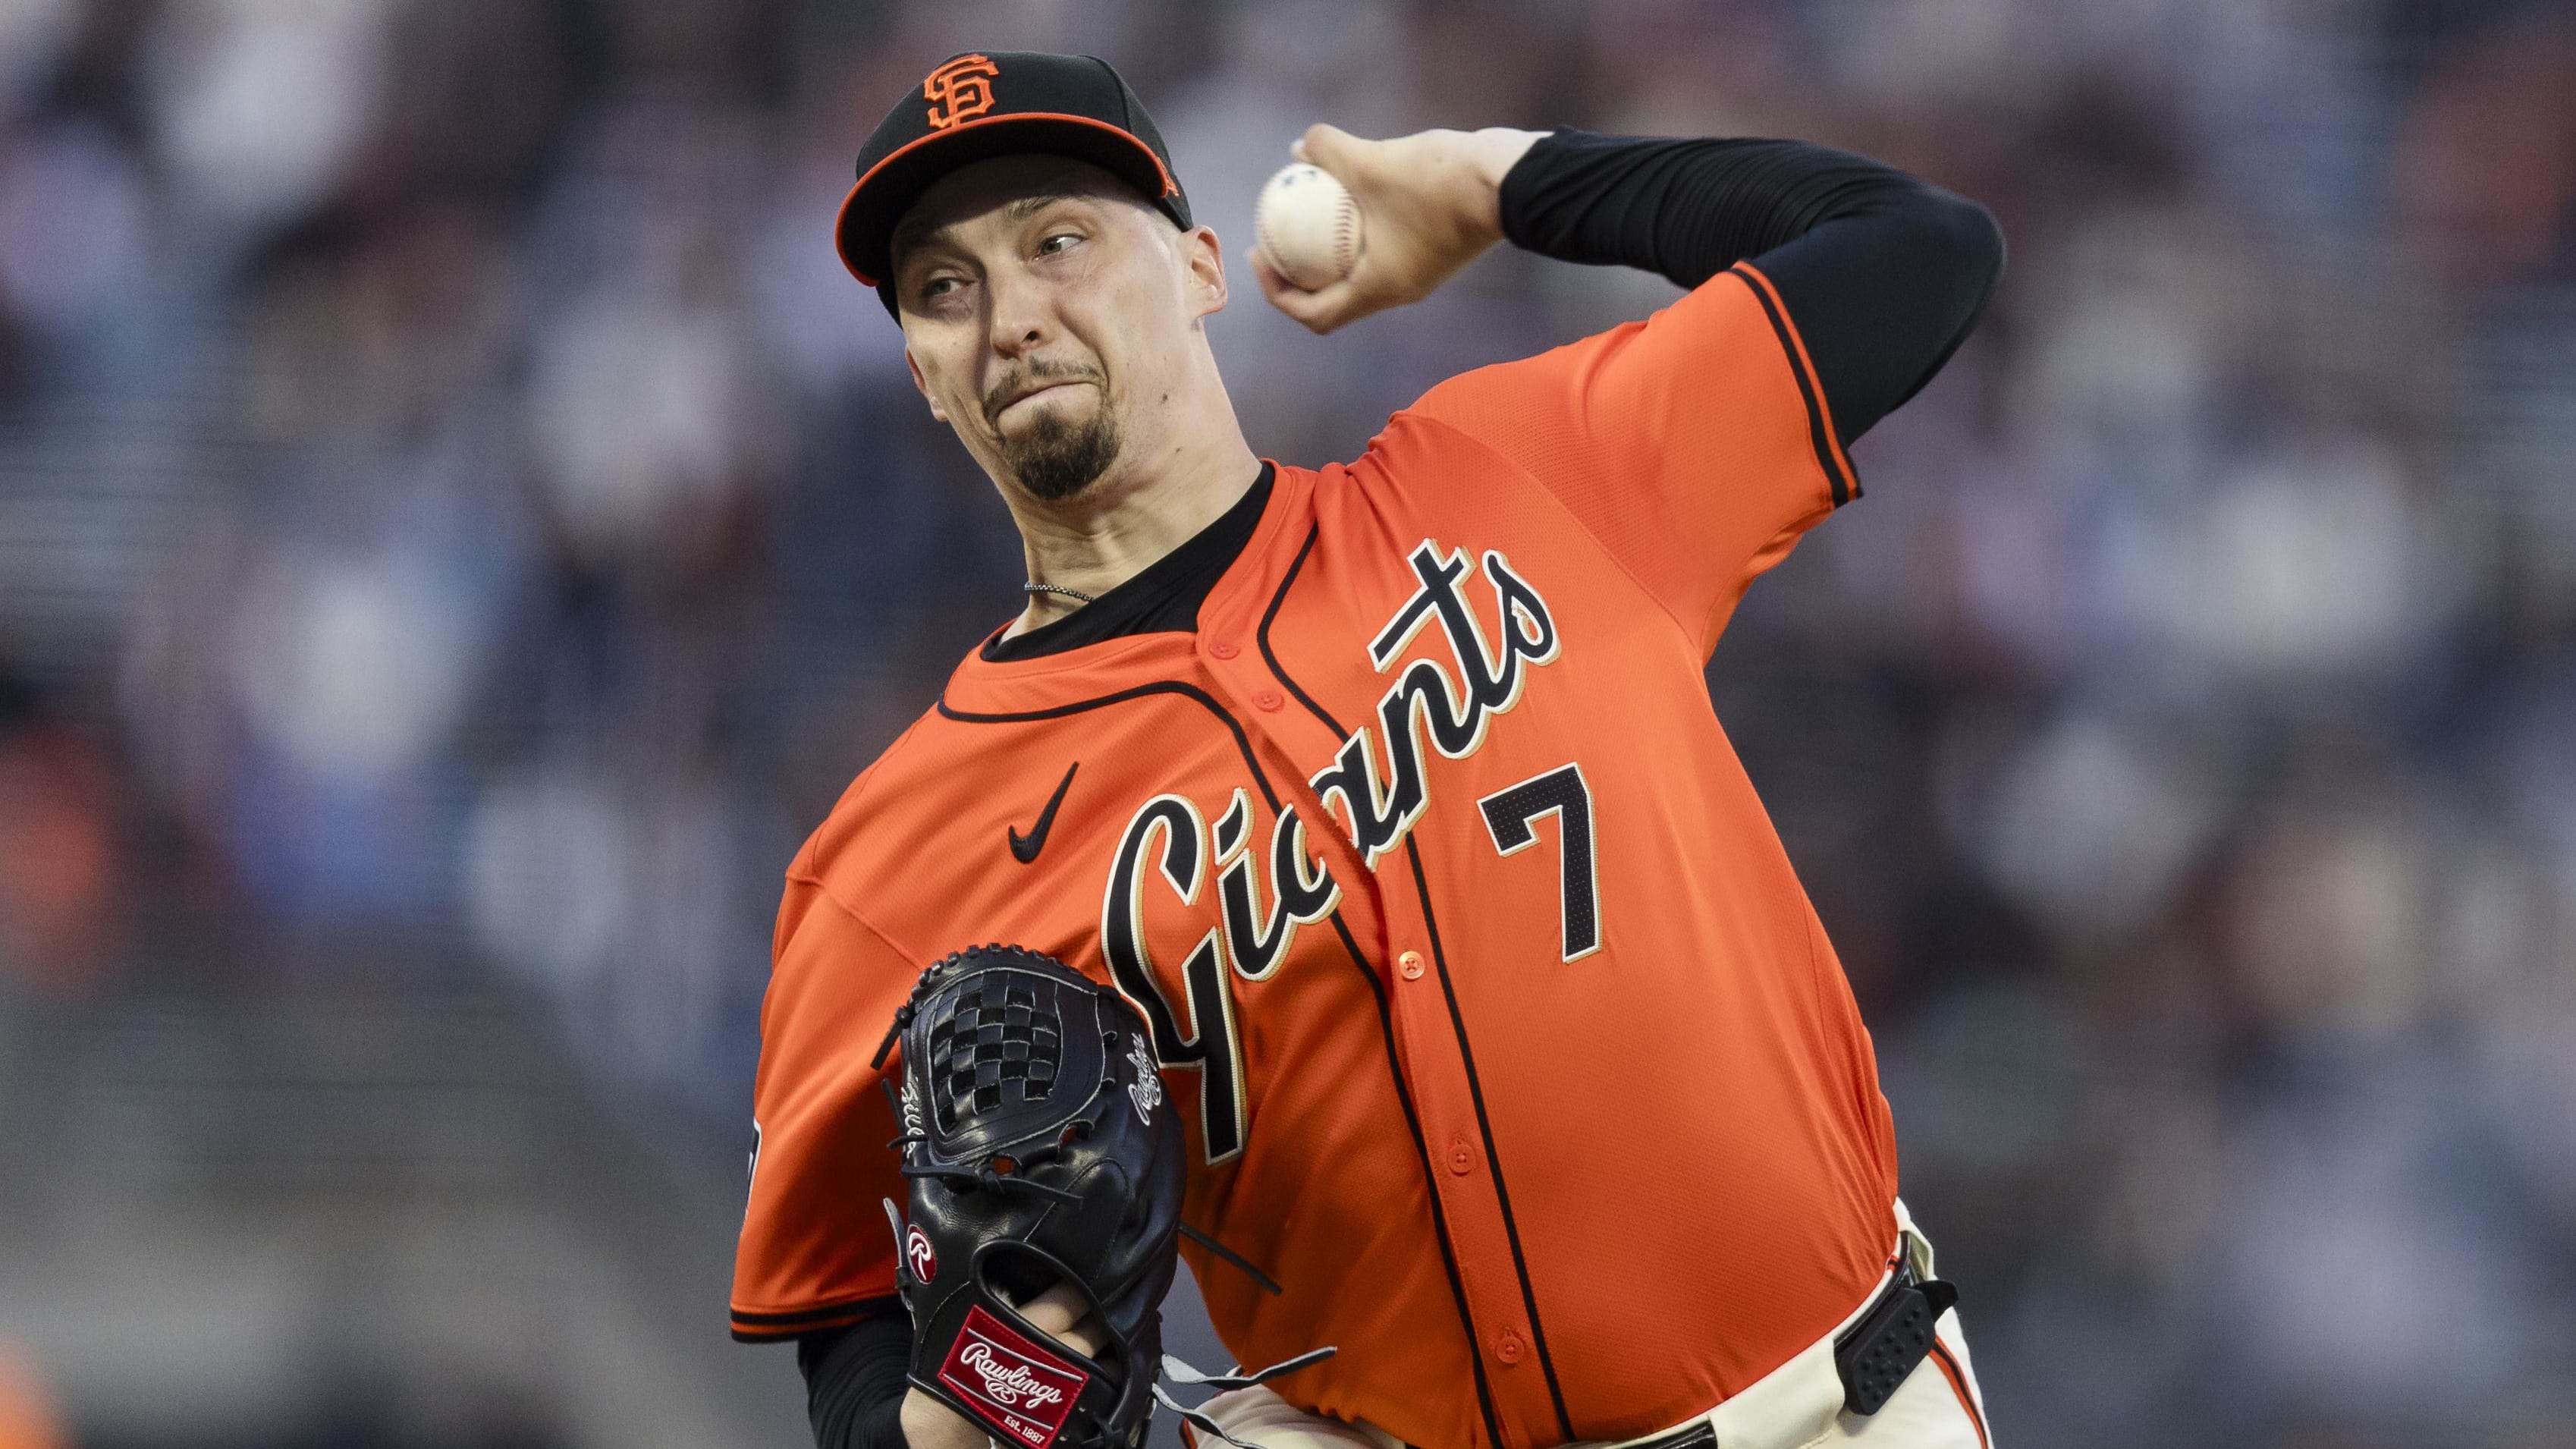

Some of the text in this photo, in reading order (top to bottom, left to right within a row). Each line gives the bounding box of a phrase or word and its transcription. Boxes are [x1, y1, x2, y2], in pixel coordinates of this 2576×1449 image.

[1101, 537, 1561, 1166] Giants
[1477, 762, 1603, 963] 7
[960, 1342, 1062, 1409] Rawlings
[1004, 1415, 1045, 1444] Est. 1887
